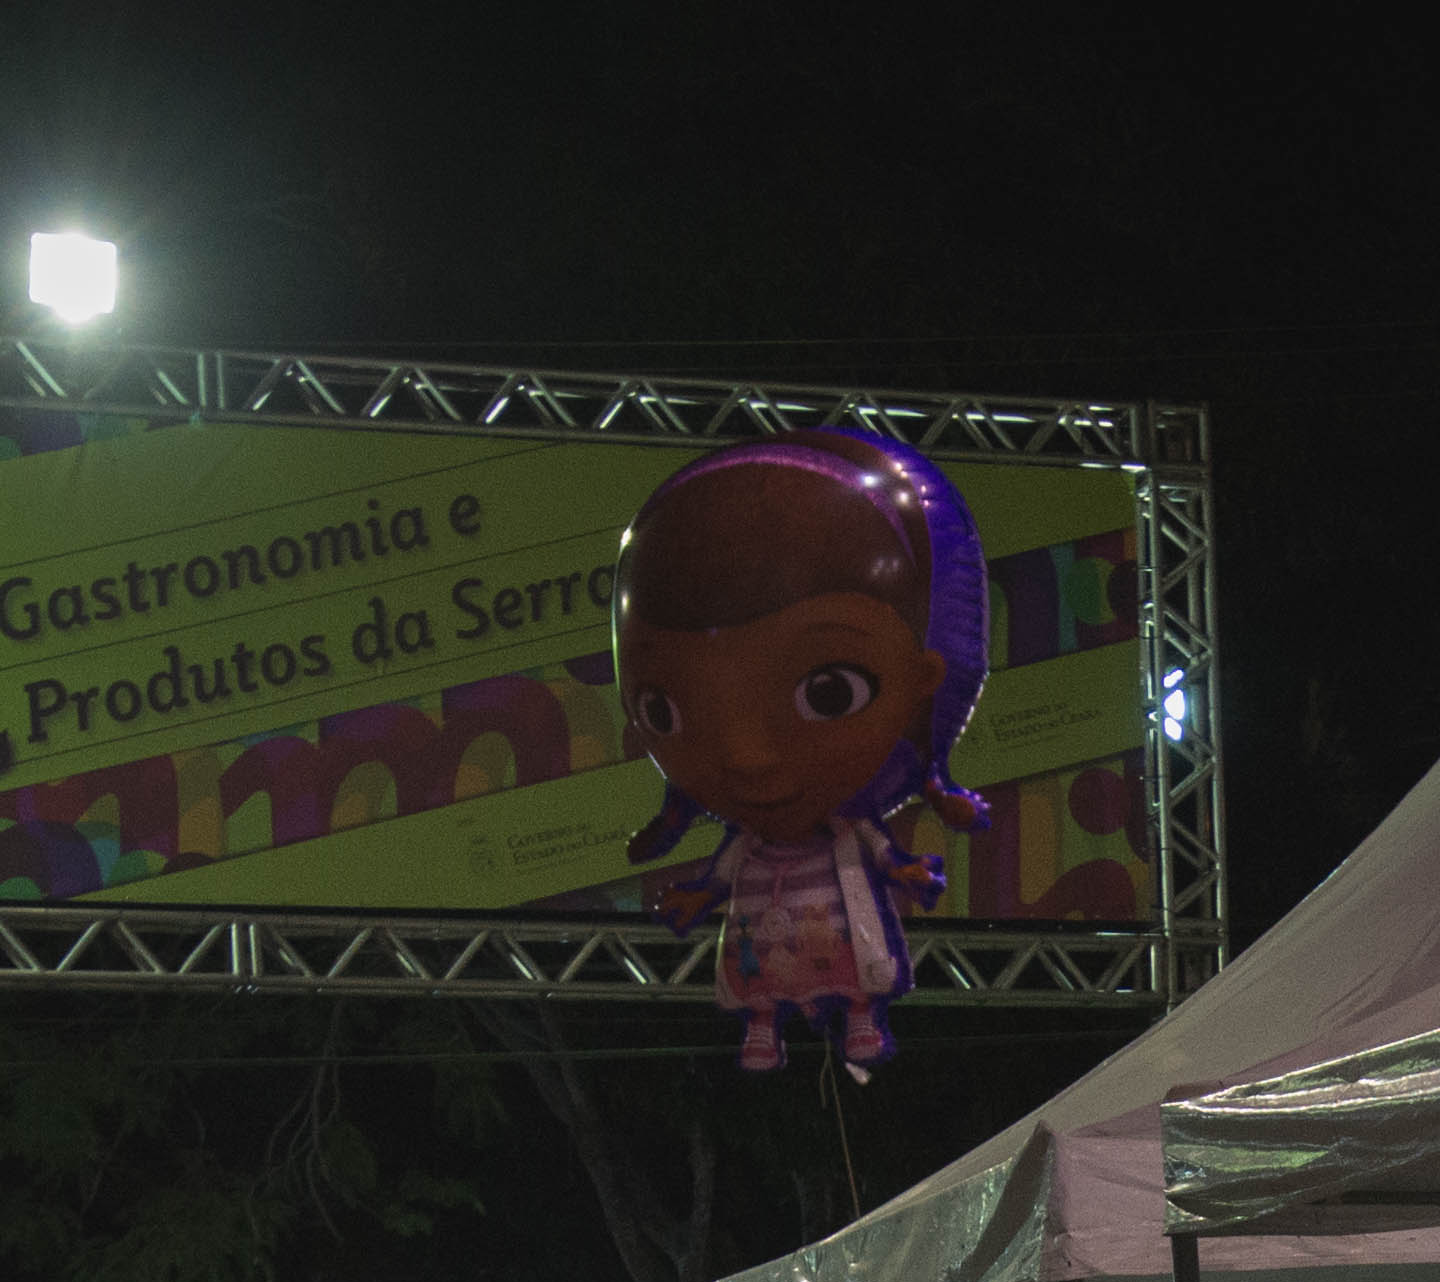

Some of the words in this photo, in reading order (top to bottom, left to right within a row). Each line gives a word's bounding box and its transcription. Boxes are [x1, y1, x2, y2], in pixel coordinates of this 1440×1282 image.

[448, 494, 482, 537] e
[25, 632, 332, 744] Produtos
[353, 598, 434, 668] da
